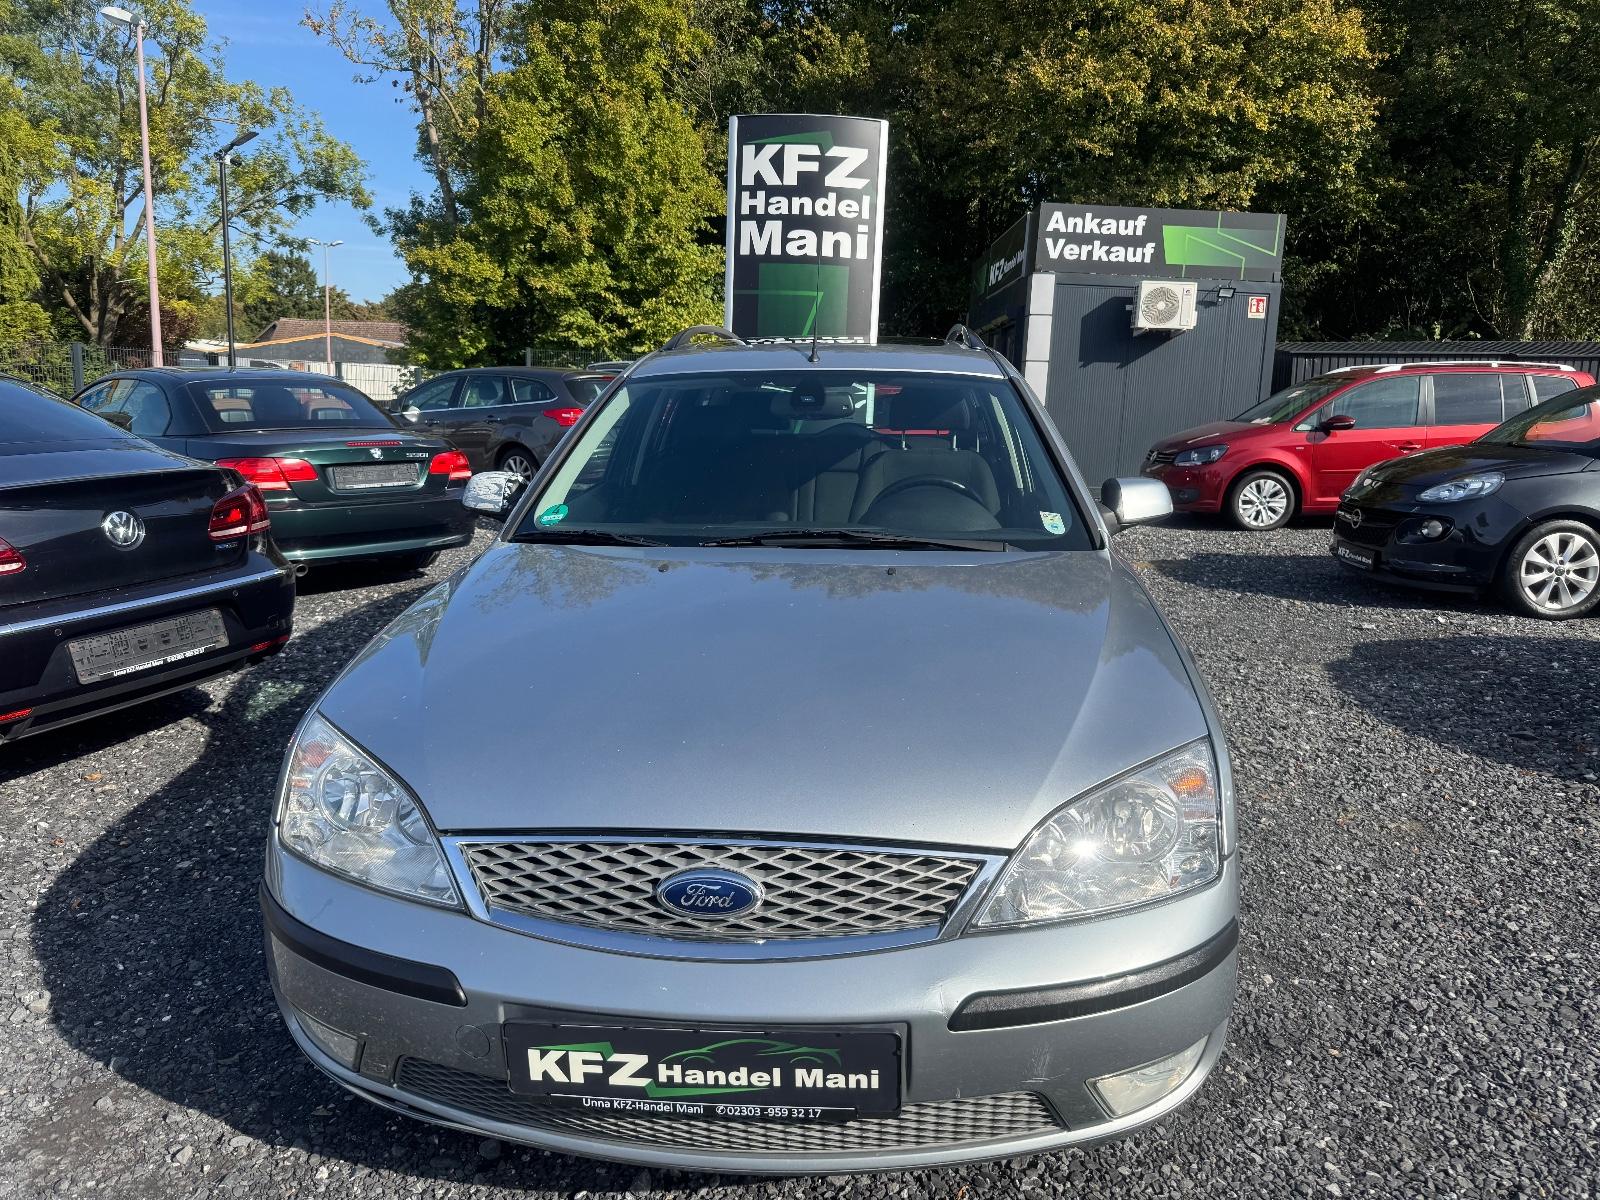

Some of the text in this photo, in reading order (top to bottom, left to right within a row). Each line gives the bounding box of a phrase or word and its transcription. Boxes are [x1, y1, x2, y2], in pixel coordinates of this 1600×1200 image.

[742, 144, 870, 189] KFZ
[740, 190, 870, 219] Handel
[1046, 211, 1148, 236] Ankauf
[739, 220, 868, 259] Mani
[1045, 237, 1156, 263] Verkauf
[680, 883, 735, 908] Ford
[527, 1048, 880, 1089] KFZ Handel Mani
[583, 1097, 611, 1108] Unna
[613, 1100, 673, 1113] KFZ-Handel
[676, 1104, 704, 1114] Mani
[763, 1107, 789, 1117] -959
[791, 1108, 805, 1118] 32
[808, 1109, 822, 1118] 17
